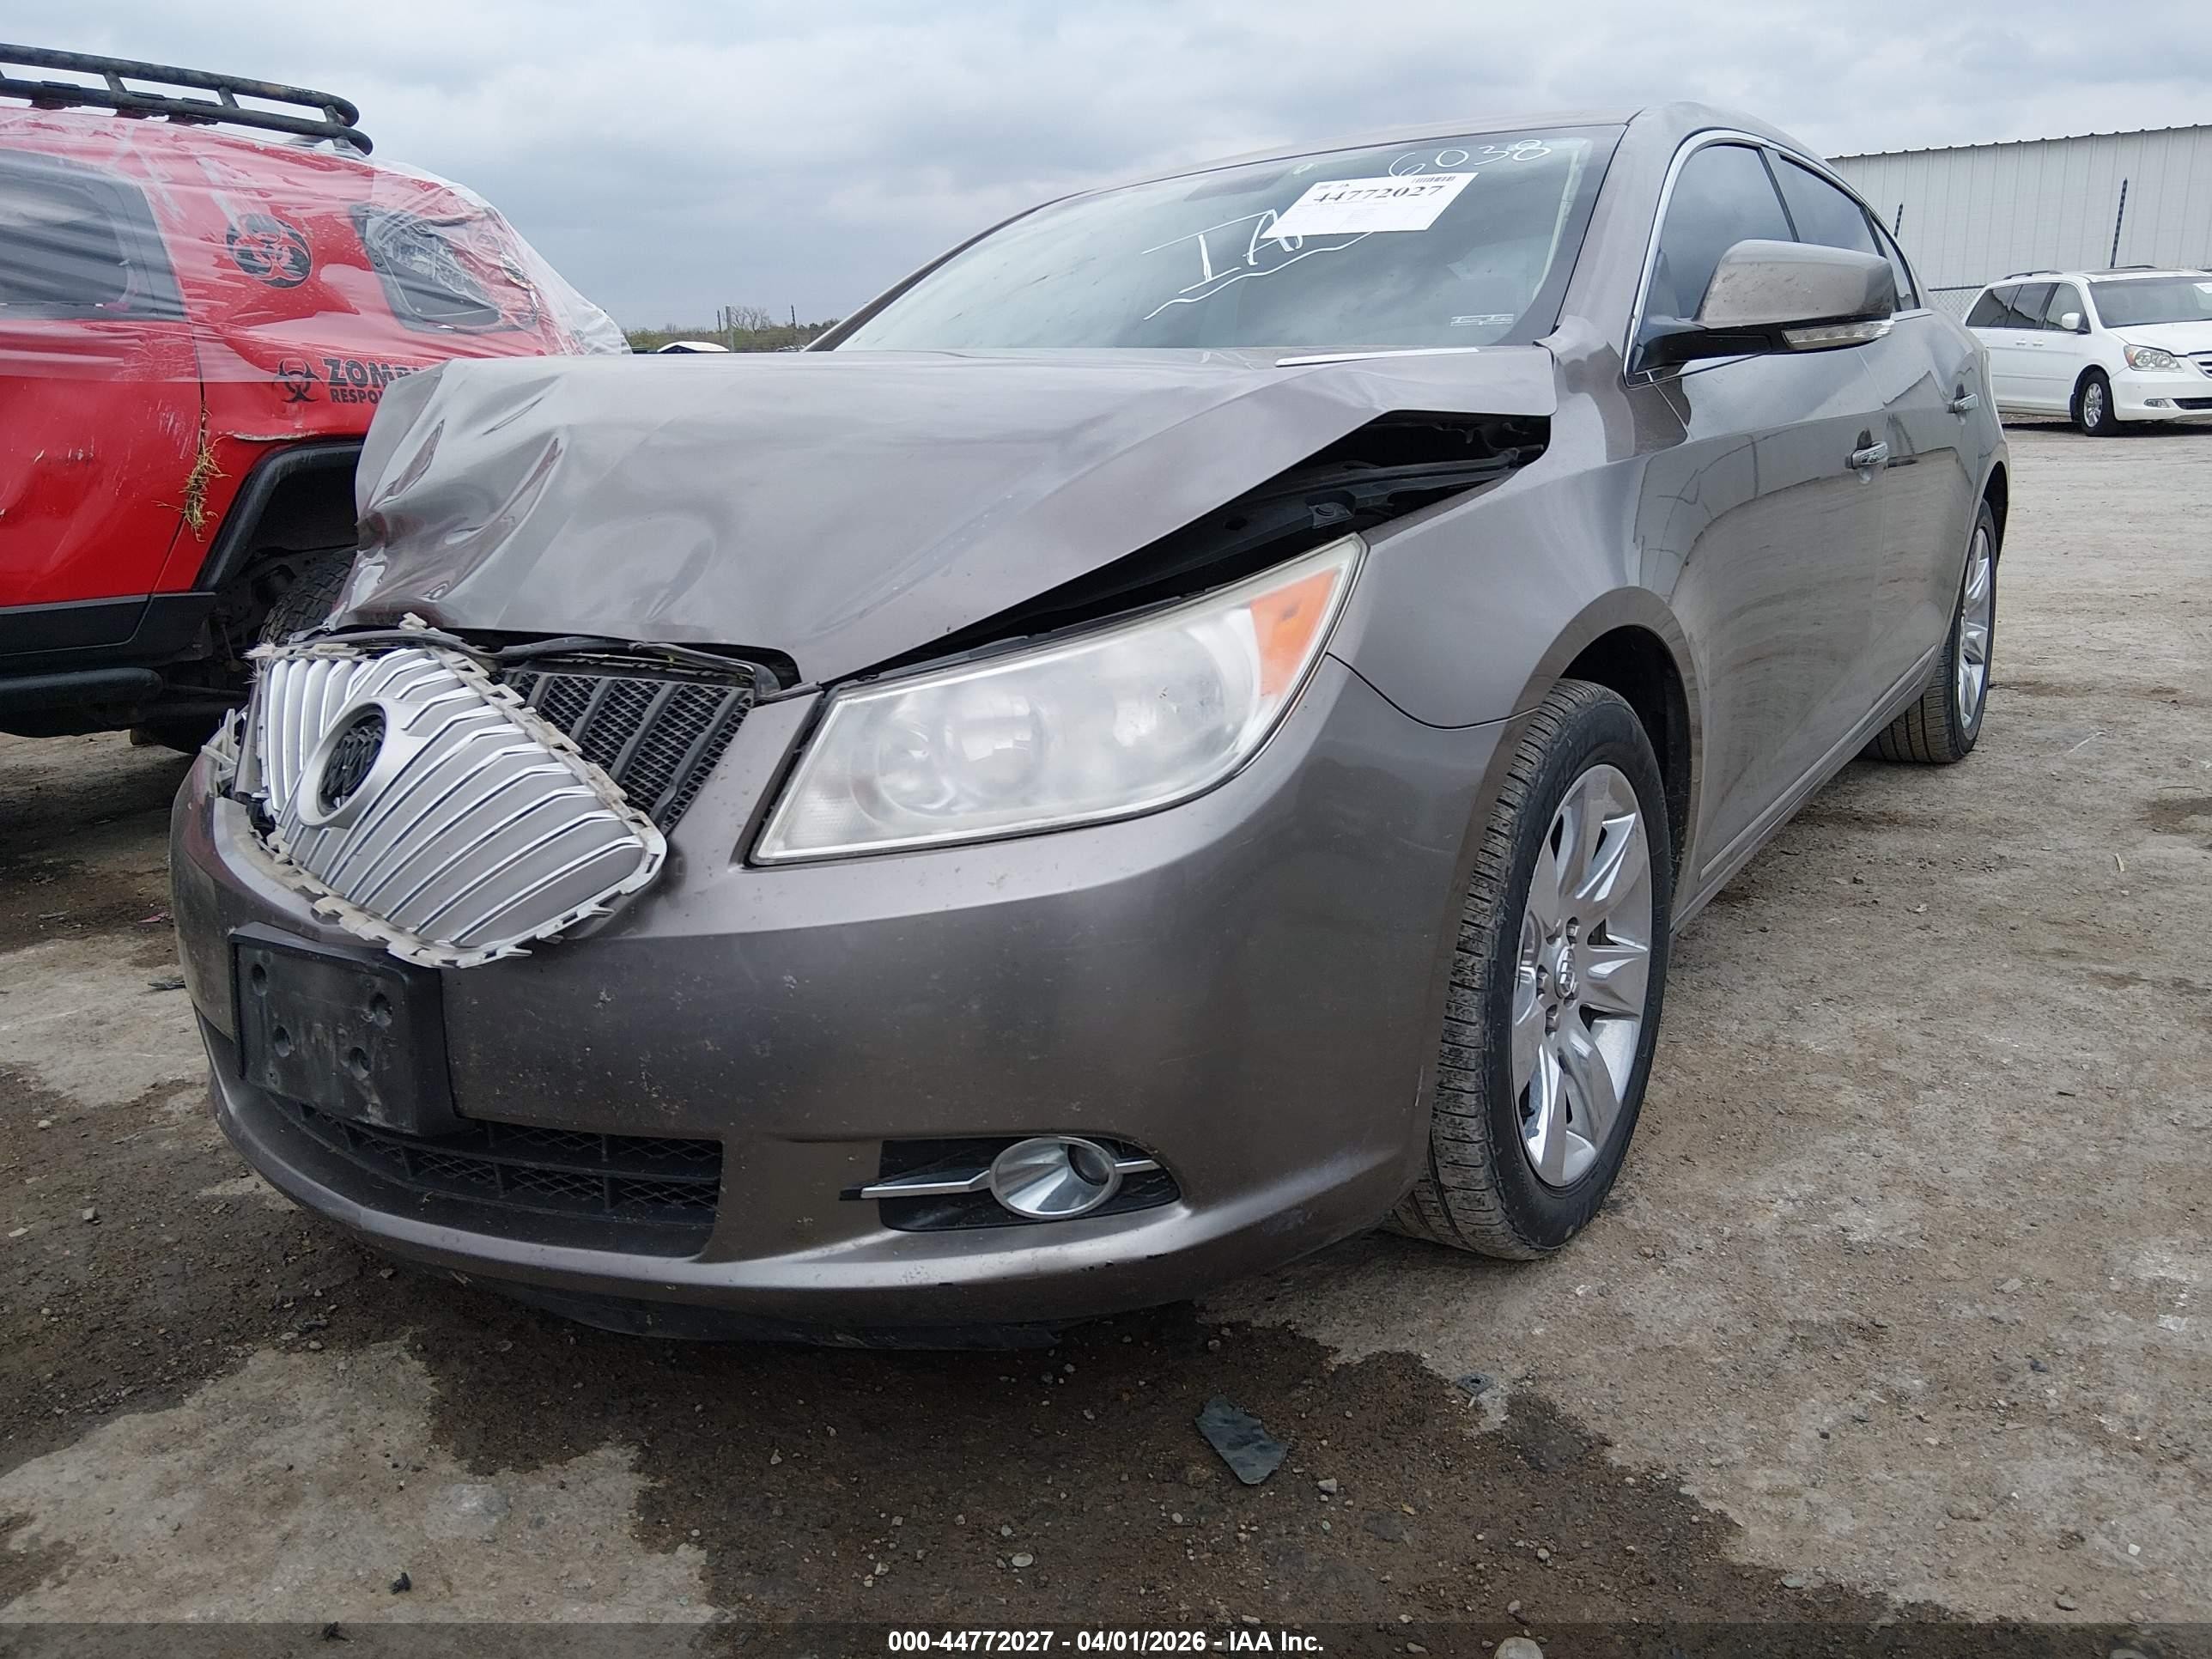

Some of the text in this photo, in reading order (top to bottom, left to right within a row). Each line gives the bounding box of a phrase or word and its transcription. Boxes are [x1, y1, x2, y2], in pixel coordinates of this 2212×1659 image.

[1388, 138, 1553, 178] 6038
[1313, 185, 1446, 204] 44772027
[330, 388, 384, 404] RESPO
